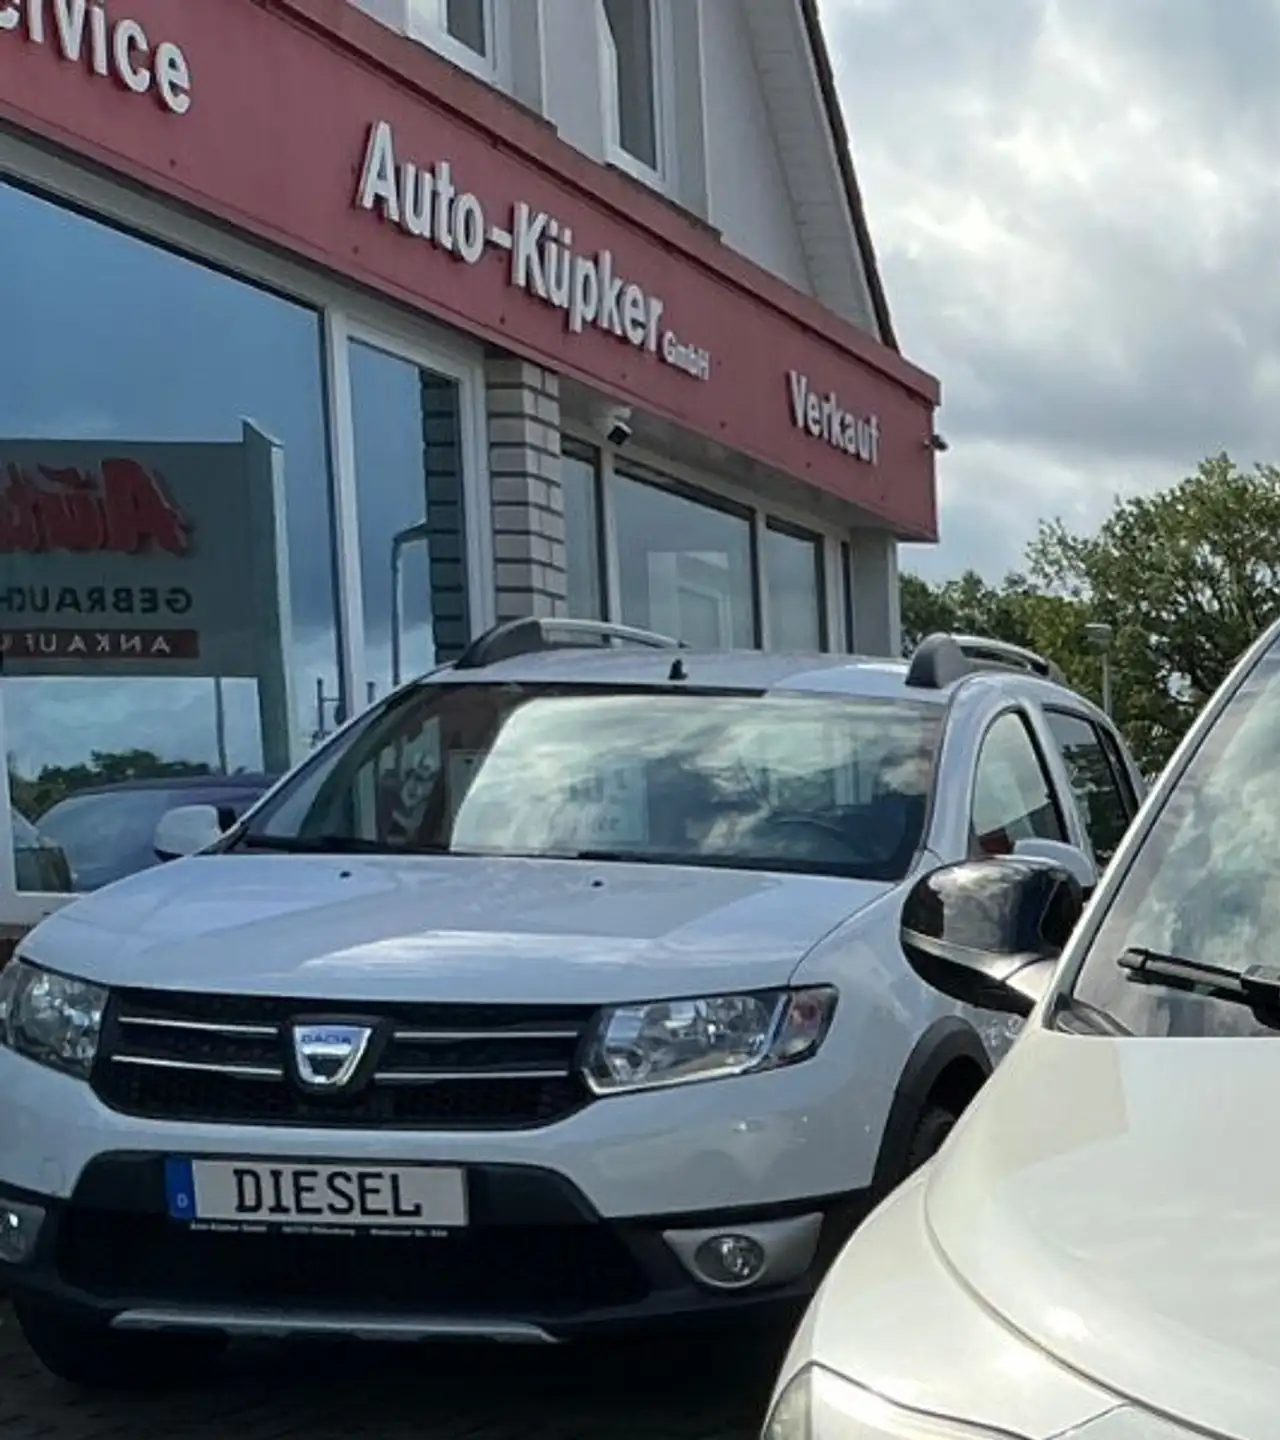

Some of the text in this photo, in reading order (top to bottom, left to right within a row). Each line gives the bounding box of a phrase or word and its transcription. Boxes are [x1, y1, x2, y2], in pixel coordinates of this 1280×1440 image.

[359, 119, 710, 381] Auto-Küpker GmbH
[788, 369, 880, 466] Verkauf
[232, 1168, 423, 1218] DIESEL
